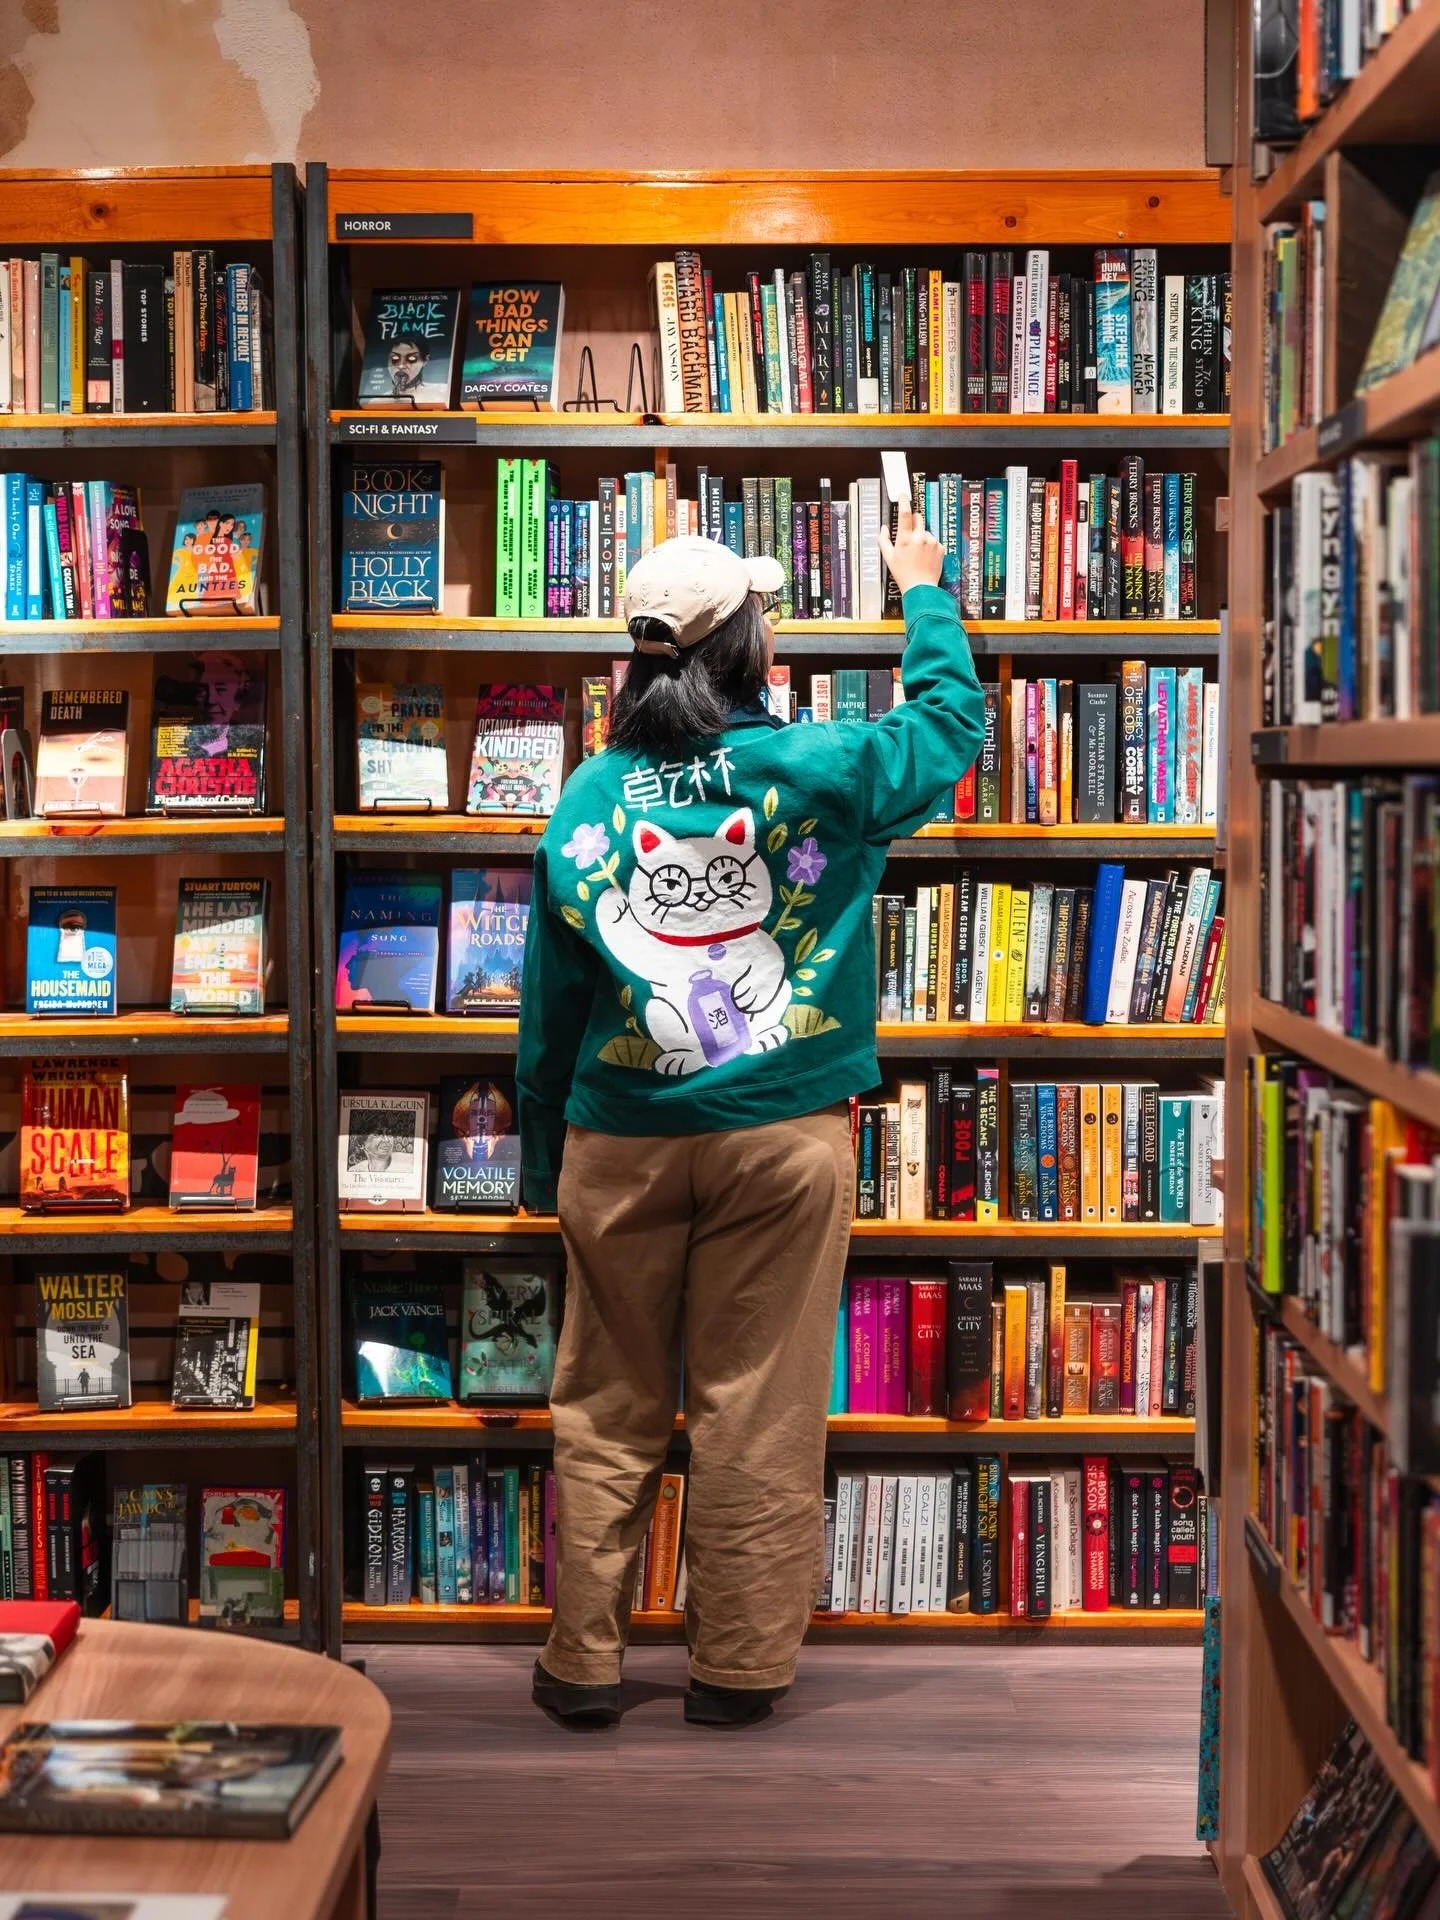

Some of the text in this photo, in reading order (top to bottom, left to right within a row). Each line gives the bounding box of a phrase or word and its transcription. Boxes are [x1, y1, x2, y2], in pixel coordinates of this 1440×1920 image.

[344, 221, 391, 231] HORROR
[814, 261, 822, 301] CASSIDY
[1101, 263, 1126, 272] DUMA
[1133, 259, 1147, 301] KING
[1147, 258, 1155, 301] STEPHEN
[488, 289, 540, 305] HOW
[494, 304, 532, 318] BAD
[236, 269, 249, 362] WRITERS IN REVOLT
[475, 319, 549, 333] THINGS
[675, 250, 703, 413] RICHARD BACHMAN
[1102, 314, 1115, 343] KING
[488, 333, 532, 347] CAN
[490, 348, 529, 362] GET
[795, 297, 808, 390] THE THIRD GRAVE
[816, 321, 830, 382] MARY
[1116, 314, 1128, 368] STEPHEN
[1028, 337, 1040, 396] PLAY NICE
[1133, 353, 1143, 395] FLINCH
[1144, 354, 1155, 395] NEVER
[465, 384, 549, 393] DARCY COATES
[349, 424, 438, 435] SCI-FI & FANTASY
[11, 480, 20, 540] The Lucky One
[1129, 461, 1138, 528] TERRY BROOKS
[1153, 480, 1161, 539] TERRY BROOKS
[1169, 480, 1177, 540] TERRY BROOKS
[1183, 477, 1192, 540] TERRY BROOKS
[968, 492, 980, 601] BLOODED ON ARACHNE
[1030, 503, 1041, 595] LORD KELVIN'S MACHINE
[352, 556, 432, 577] HOLLY
[1125, 564, 1133, 600] DEMON
[63, 568, 74, 609] CECILIA TAN
[351, 580, 430, 598] BLACK
[51, 706, 82, 719] DEATH
[52, 690, 122, 704] REMEMBERED
[1125, 686, 1134, 741] OF GODS
[477, 736, 557, 759] KINDRED
[983, 712, 996, 771] FAITHLESS
[1089, 725, 1095, 736] &
[1089, 738, 1095, 749] Mr
[1156, 682, 1167, 804] LEVIATHAN WAKES
[158, 758, 253, 776] AGATHA
[1097, 712, 1106, 806] JONATHAN STRANGE
[155, 777, 257, 795] CHRISTIE
[620, 747, 736, 812] 乾杯
[1164, 900, 1182, 965] THE FOREVER WAR
[1179, 922, 1195, 976] JOE HALDEMAN
[929, 922, 937, 995] BURNING CHROME
[31, 980, 111, 997] HOUSEMAID
[953, 963, 961, 994] country
[31, 1058, 120, 1069] LAWRENCE
[32, 1071, 97, 1081] WRIGHT
[32, 1088, 118, 1130] HUMAN
[980, 1090, 988, 1146] WE BECAME
[988, 1085, 997, 1128] THE CITY
[1127, 1091, 1137, 1112] THOSE
[1019, 1104, 1031, 1171] FIFTH SEASON
[1127, 1113, 1137, 1140] BEYOND
[1144, 1092, 1155, 1162] THE LEOPARD
[31, 1131, 118, 1176] SCALE
[887, 1120, 899, 1181] Hellstrom's Hive
[1127, 1142, 1137, 1153] THE
[442, 1166, 515, 1180] VOLATILE
[442, 1180, 515, 1195] MEMORY
[938, 1165, 946, 1202] CONAN
[39, 1274, 124, 1300] WALTER
[51, 1300, 114, 1320] MOSLEY
[370, 1305, 444, 1318] JACK VANCE
[1029, 1326, 1038, 1339] the
[1028, 1340, 1038, 1362] Stone
[1028, 1363, 1037, 1387] House
[938, 1482, 947, 1524] SCALZI
[11, 1460, 30, 1594] CITY IN RUINS DON WINSLOW
[367, 1509, 383, 1566] GIDEON
[936, 1534, 944, 1542] THE
[1173, 1520, 1193, 1528] song
[936, 1543, 944, 1553] END
[936, 1562, 944, 1570] ALL
